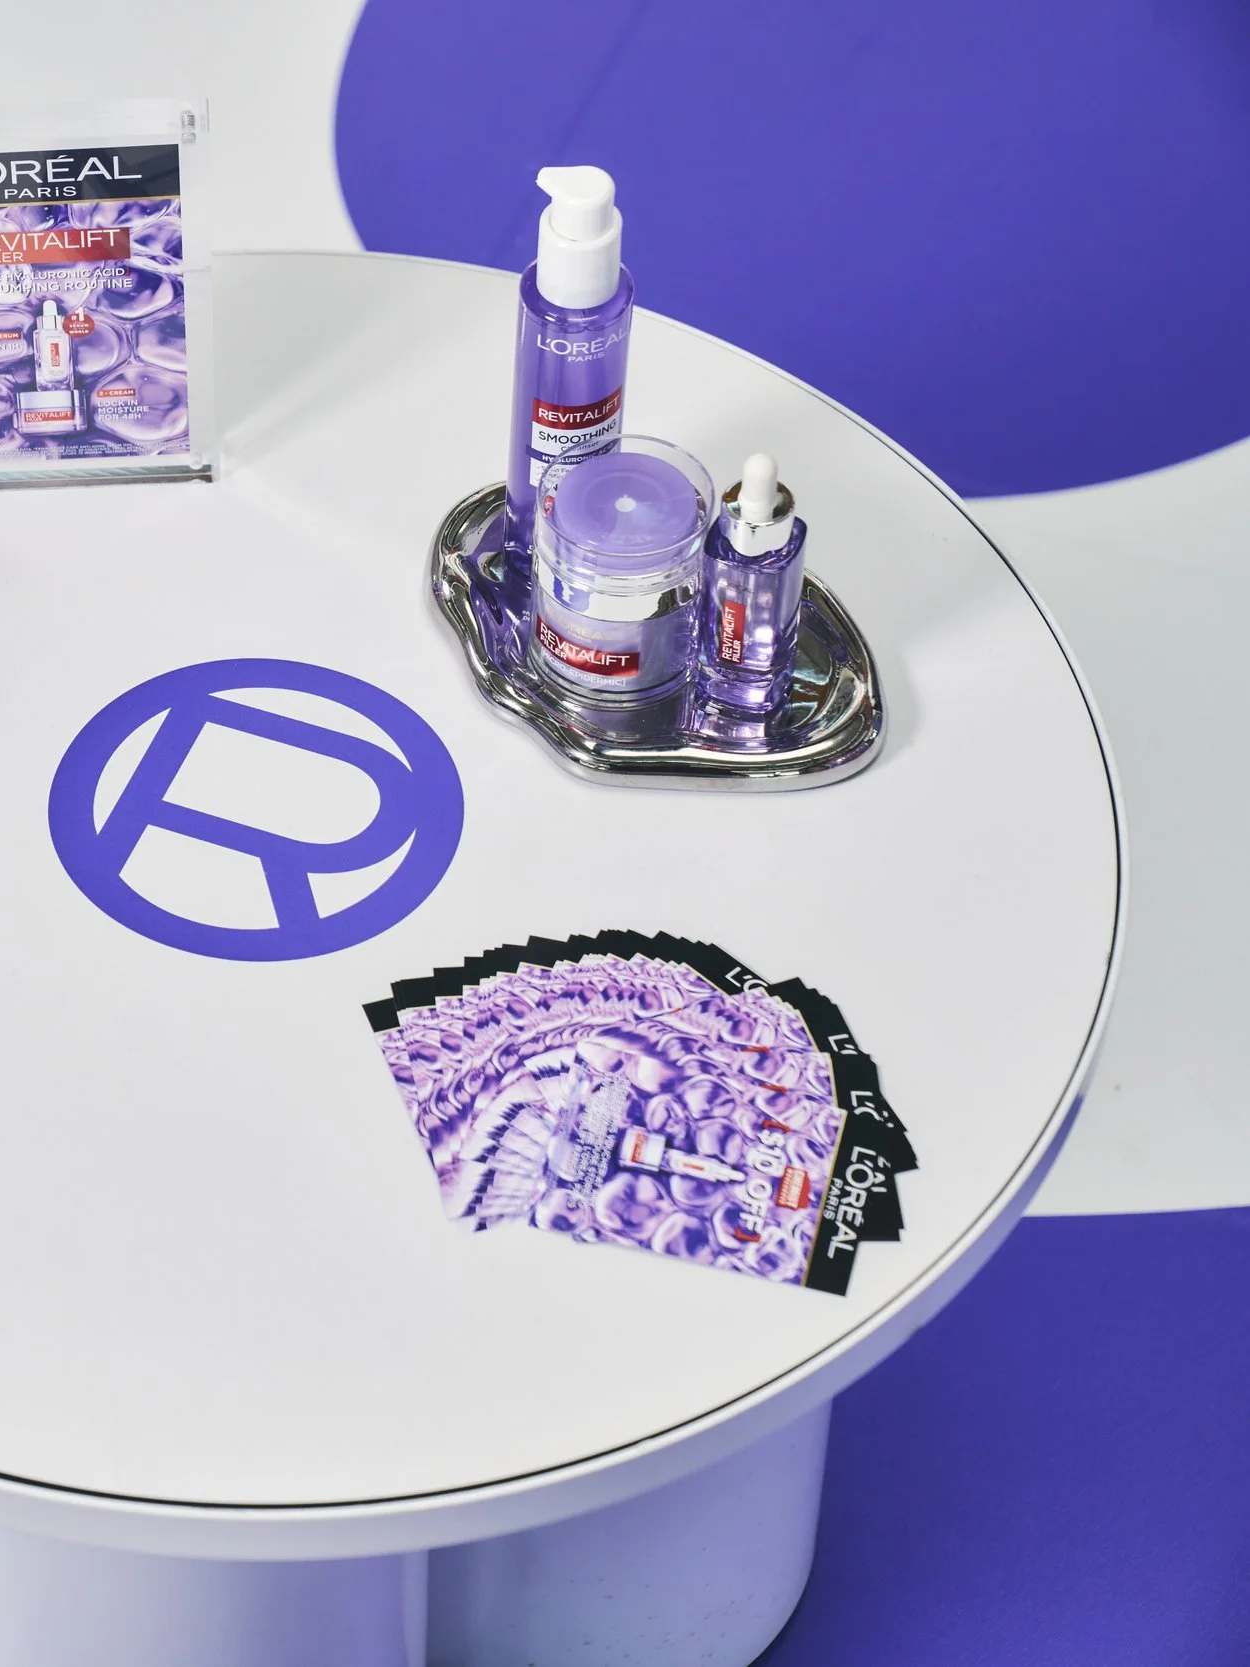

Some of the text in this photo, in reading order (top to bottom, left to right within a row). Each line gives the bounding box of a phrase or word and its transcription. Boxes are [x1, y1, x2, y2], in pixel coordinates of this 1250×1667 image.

[5, 270, 91, 282] HYALURONIC
[64, 278, 133, 291] ROUTINE
[537, 328, 628, 355] L'ORÉAL
[97, 405, 150, 414] MOISTURE
[538, 394, 620, 423] REVITALIFT
[538, 418, 616, 445] SMOOTHING
[540, 622, 630, 667] REVITALIFT
[540, 633, 567, 660] FILLER
[722, 606, 736, 660] REVITALIFT
[732, 639, 741, 662] FILLER
[827, 1146, 876, 1259] L'ORÉAL
